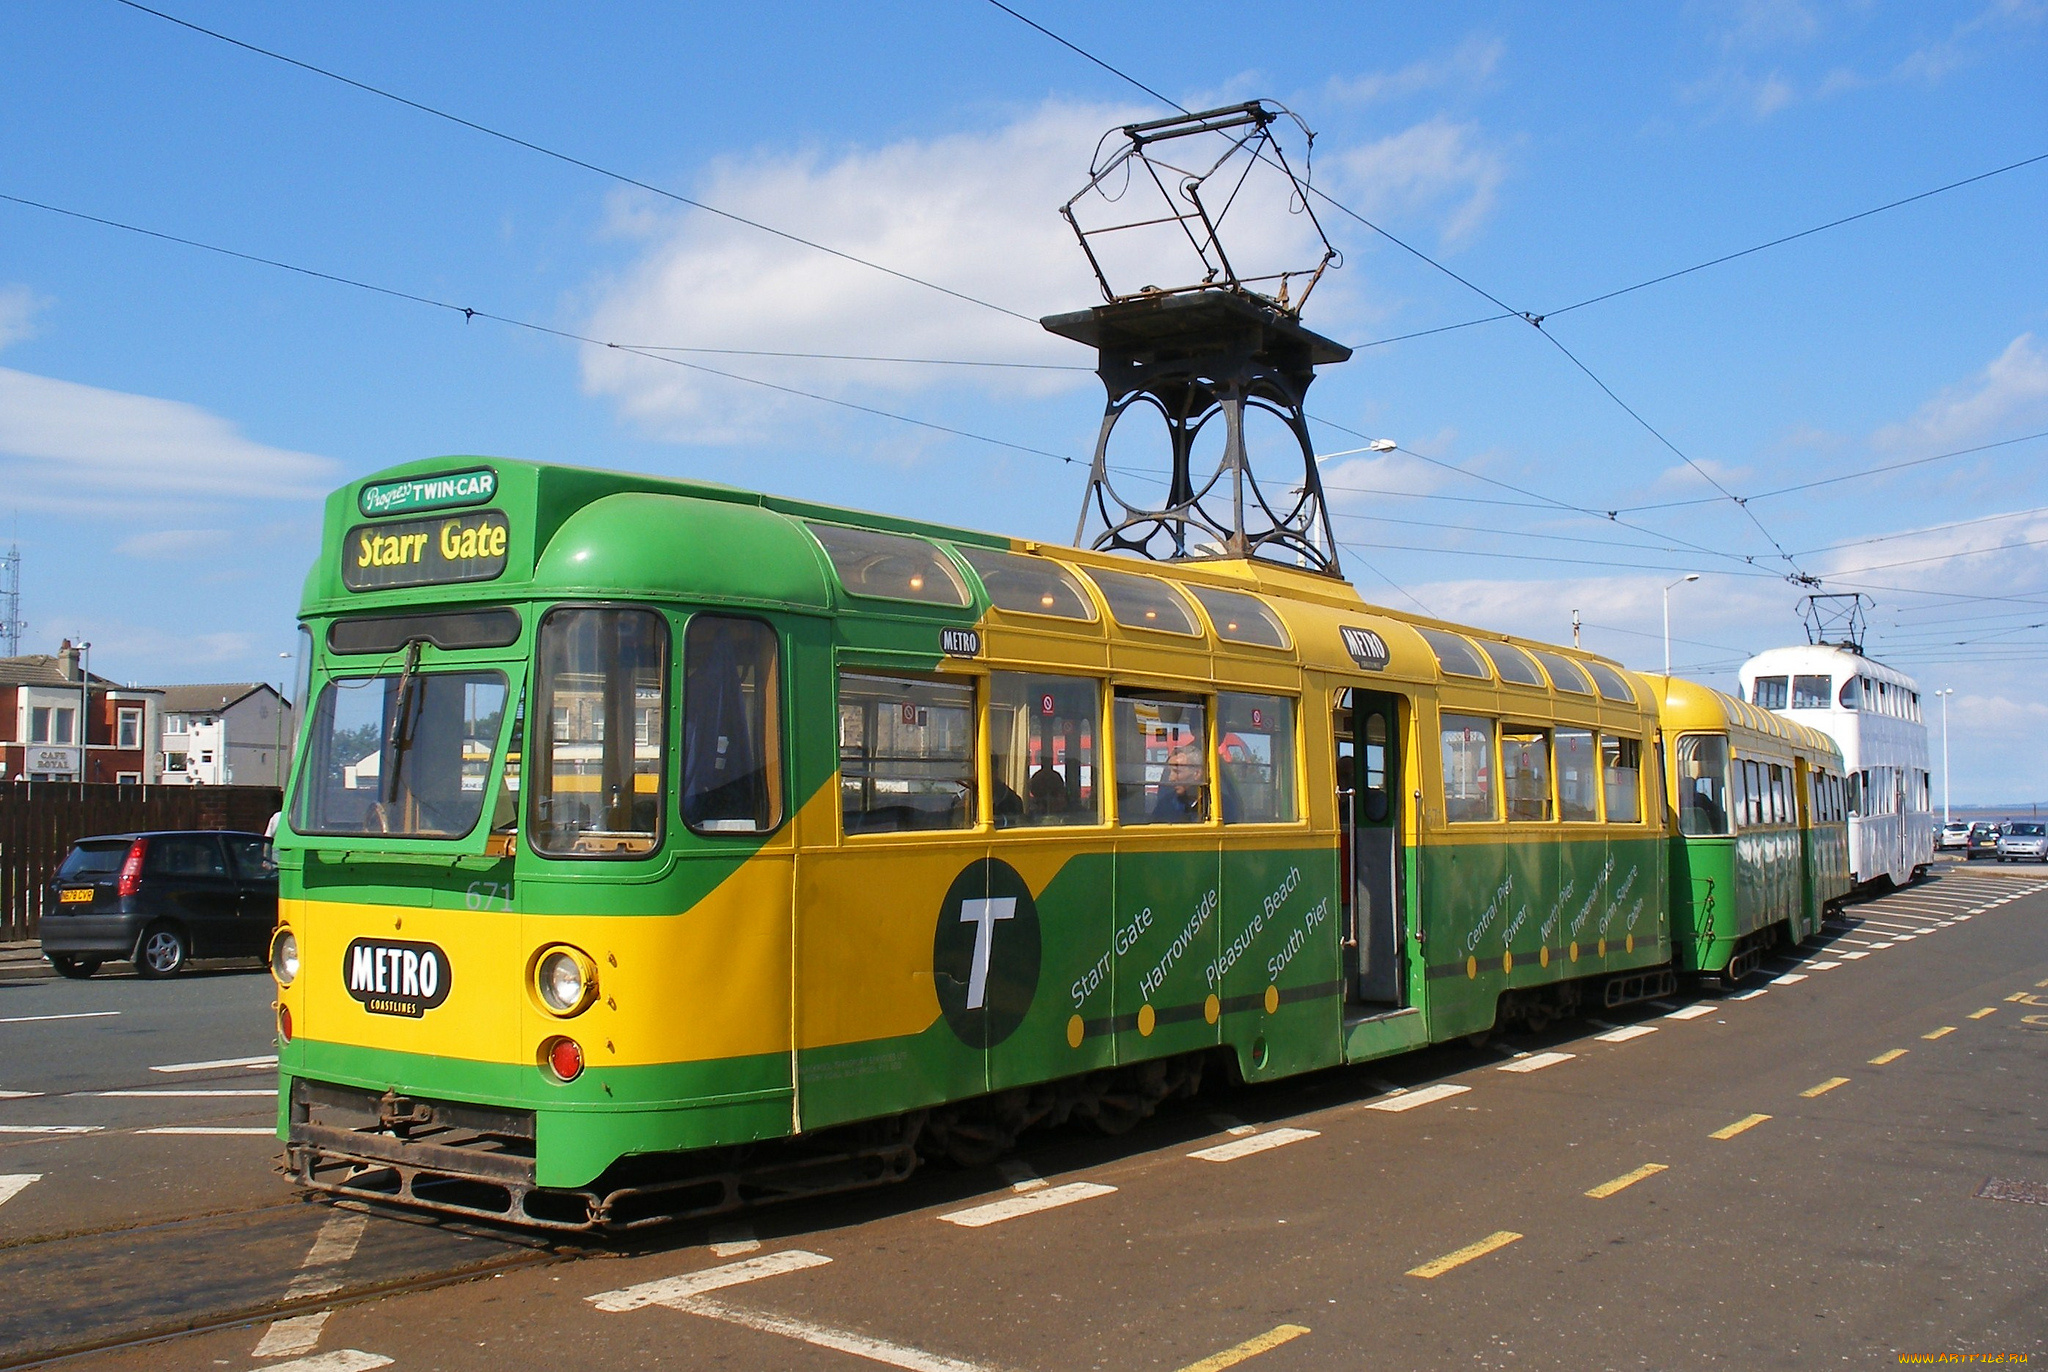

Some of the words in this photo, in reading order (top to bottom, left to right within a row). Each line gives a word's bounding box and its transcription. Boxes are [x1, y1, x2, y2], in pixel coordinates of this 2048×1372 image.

[358, 527, 428, 568] Starr
[440, 518, 507, 560] Gate
[943, 630, 977, 652] METRO
[1342, 628, 1386, 659] METRO
[37, 760, 70, 769] ROYAL
[40, 751, 66, 760] CAFE
[465, 881, 513, 913] 671
[1466, 895, 1498, 952] Central
[1497, 873, 1513, 906] Pier
[1138, 888, 1218, 1002] Harrowside
[1204, 913, 1264, 990] Pleasure
[1262, 865, 1301, 920] Beach
[1266, 929, 1305, 983] South
[1305, 896, 1329, 937] Pier
[1501, 903, 1527, 949] Tower
[1540, 903, 1559, 943] North
[350, 945, 439, 999] METRO
[959, 896, 1018, 1010] T
[1070, 948, 1111, 1009] Starr
[1113, 905, 1154, 957] Gate
[370, 999, 416, 1014] COASTLINES
